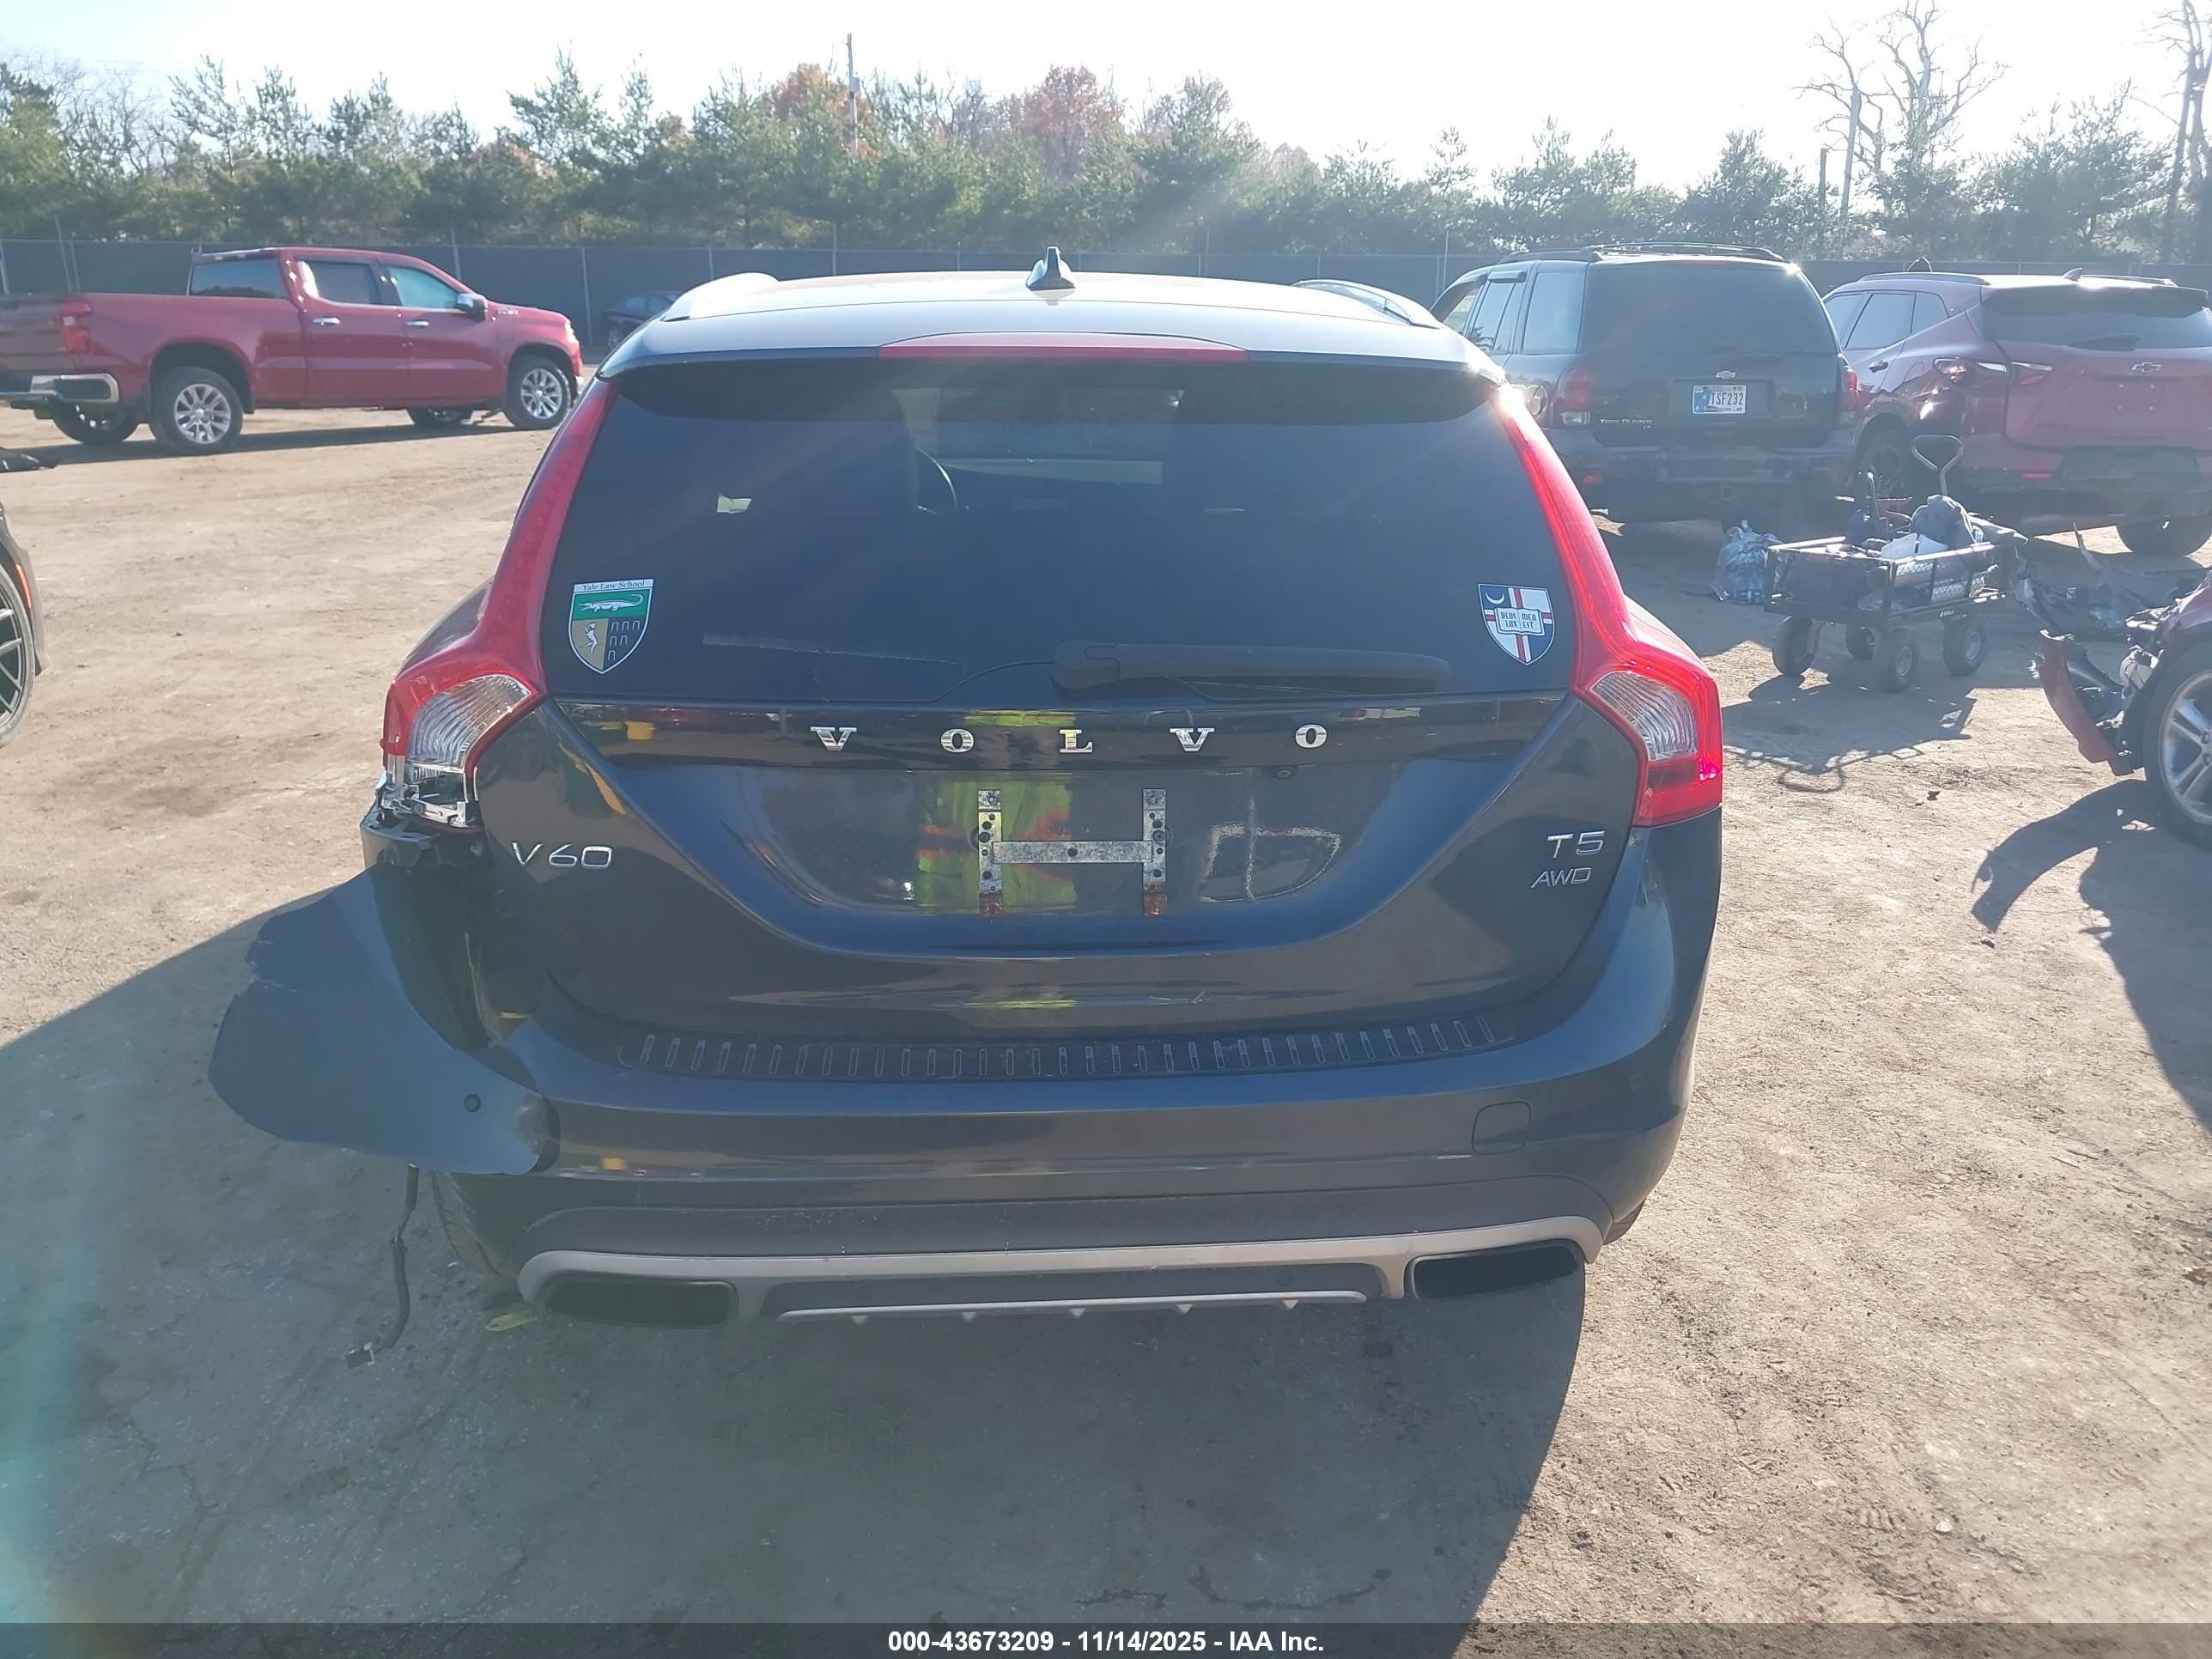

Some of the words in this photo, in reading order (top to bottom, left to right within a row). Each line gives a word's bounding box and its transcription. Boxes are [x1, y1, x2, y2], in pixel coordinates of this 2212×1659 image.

[1711, 392, 1744, 405] TSF232
[619, 580, 645, 589] School
[1500, 611, 1516, 620] DEUS
[1522, 621, 1534, 629] EST
[810, 724, 1328, 753] VOLVO
[1547, 830, 1606, 859] T5
[511, 842, 613, 868] V60
[1530, 867, 1592, 889] AWD
